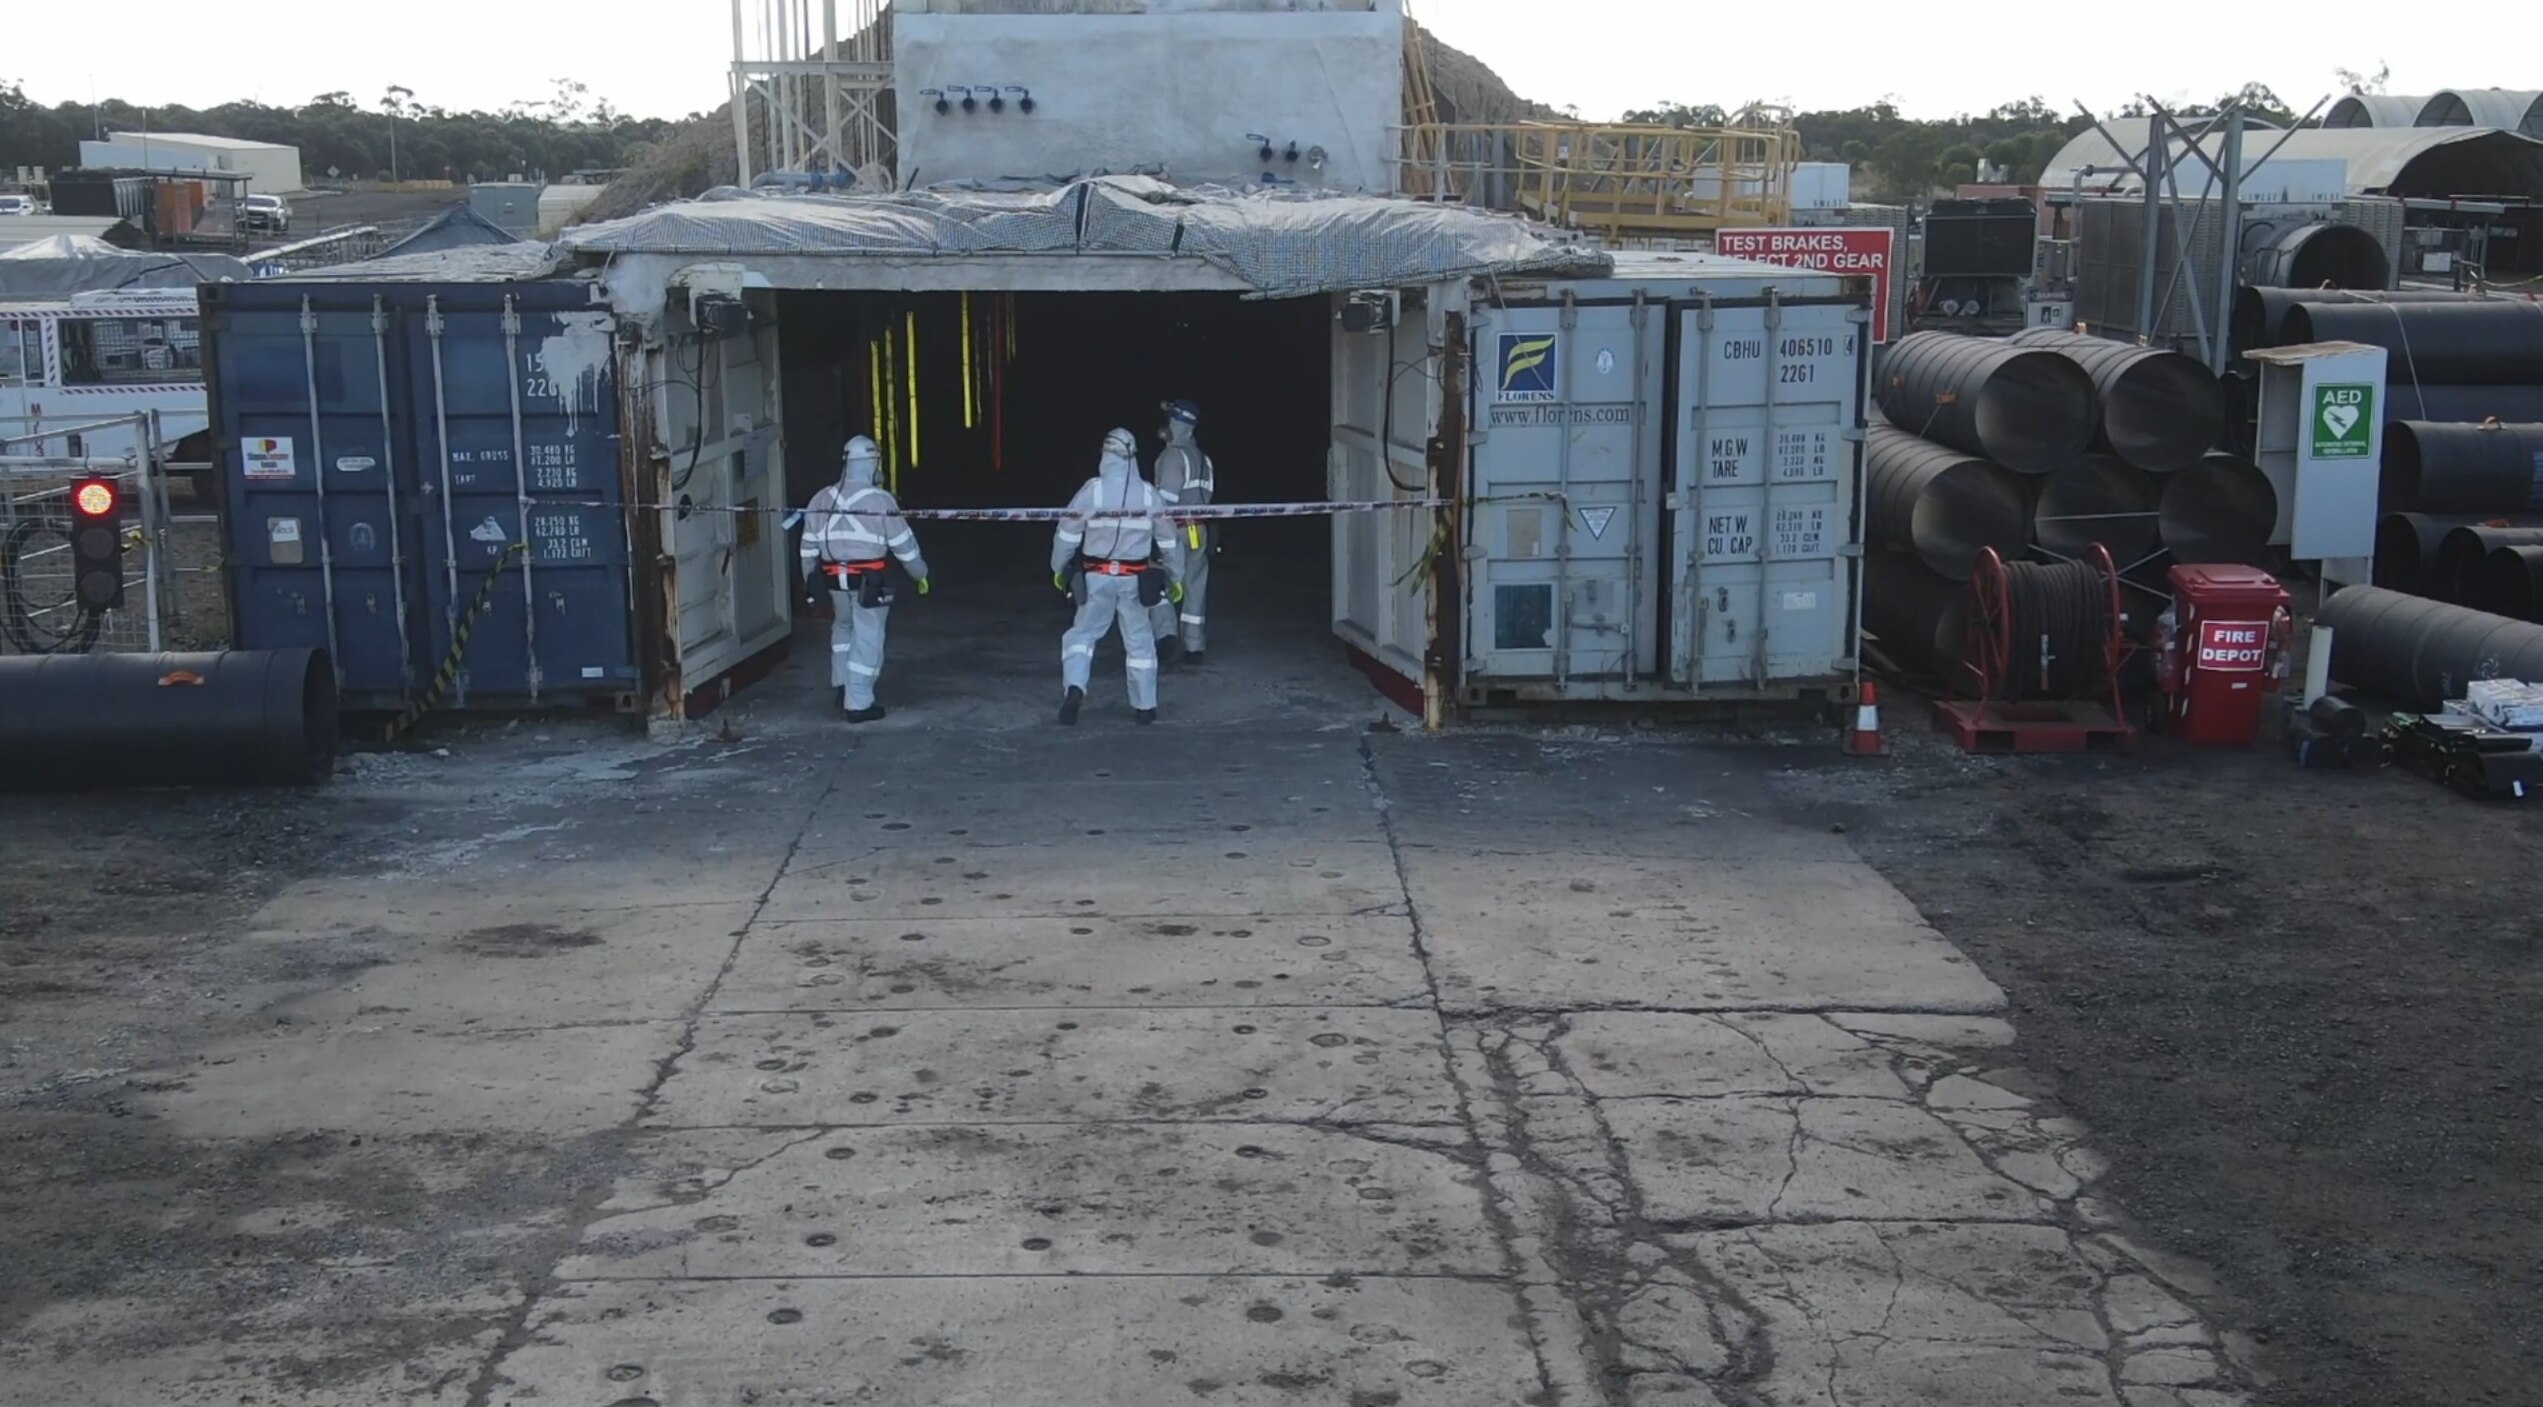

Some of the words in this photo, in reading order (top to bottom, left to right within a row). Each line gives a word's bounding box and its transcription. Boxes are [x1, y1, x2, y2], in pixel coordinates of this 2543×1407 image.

[1723, 236, 1766, 251] TEST
[1771, 235, 1848, 253] BRAKES,
[1723, 254, 1789, 267] LECT
[1793, 254, 1828, 269] 2ND
[1833, 253, 1884, 269] GEAR
[1724, 340, 1761, 360] CBHU
[1779, 337, 1833, 358] 406510
[1498, 391, 1555, 402] FLORENS
[2322, 390, 2362, 405] AED
[1491, 405, 1630, 424] www.florns.com
[1711, 460, 1740, 479] TARE
[1709, 515, 1732, 535] NET
[2213, 630, 2257, 643] FIRE
[2202, 648, 2262, 661] DEPOT
